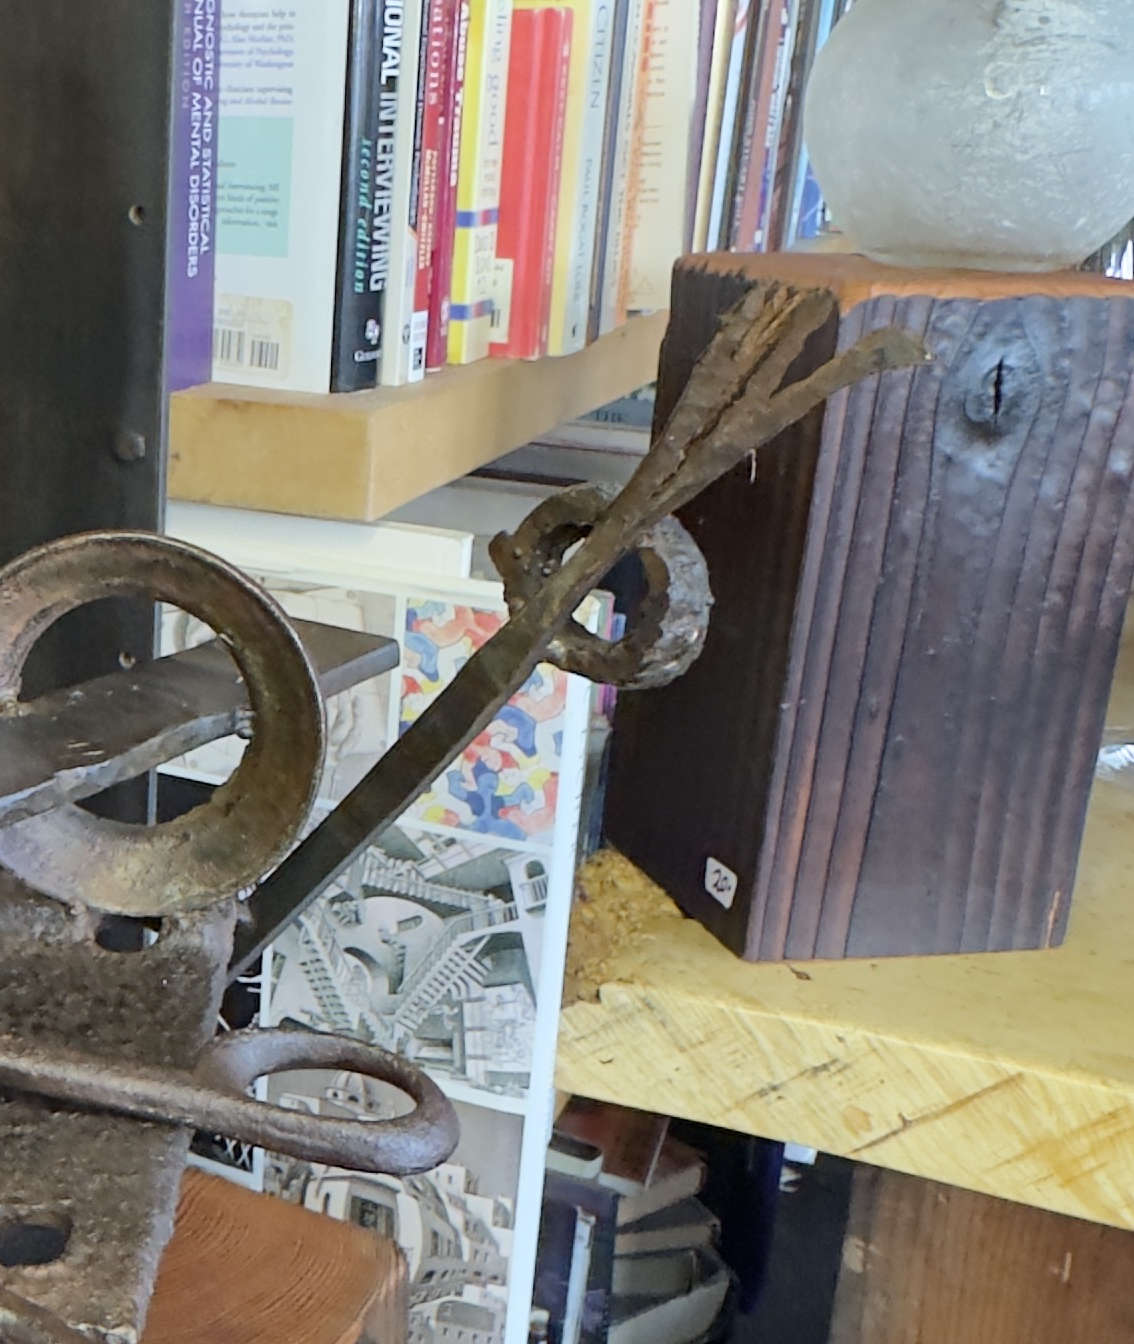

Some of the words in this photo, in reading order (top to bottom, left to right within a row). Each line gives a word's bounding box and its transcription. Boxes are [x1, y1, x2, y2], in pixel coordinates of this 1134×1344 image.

[180, 26, 191, 108] EDITION
[192, 58, 202, 87] OF
[456, 2, 469, 81] Abuse
[589, 4, 609, 109] CITIZEN
[189, 92, 202, 170] MENTAL
[200, 98, 212, 142] AND
[449, 87, 463, 187] Trauma
[483, 73, 505, 145] good
[198, 148, 212, 256] STATISTICAL
[356, 137, 374, 208] second
[368, 91, 397, 291] INTERVIEWING
[186, 175, 200, 278] DISORDERS
[352, 217, 369, 294] edition
